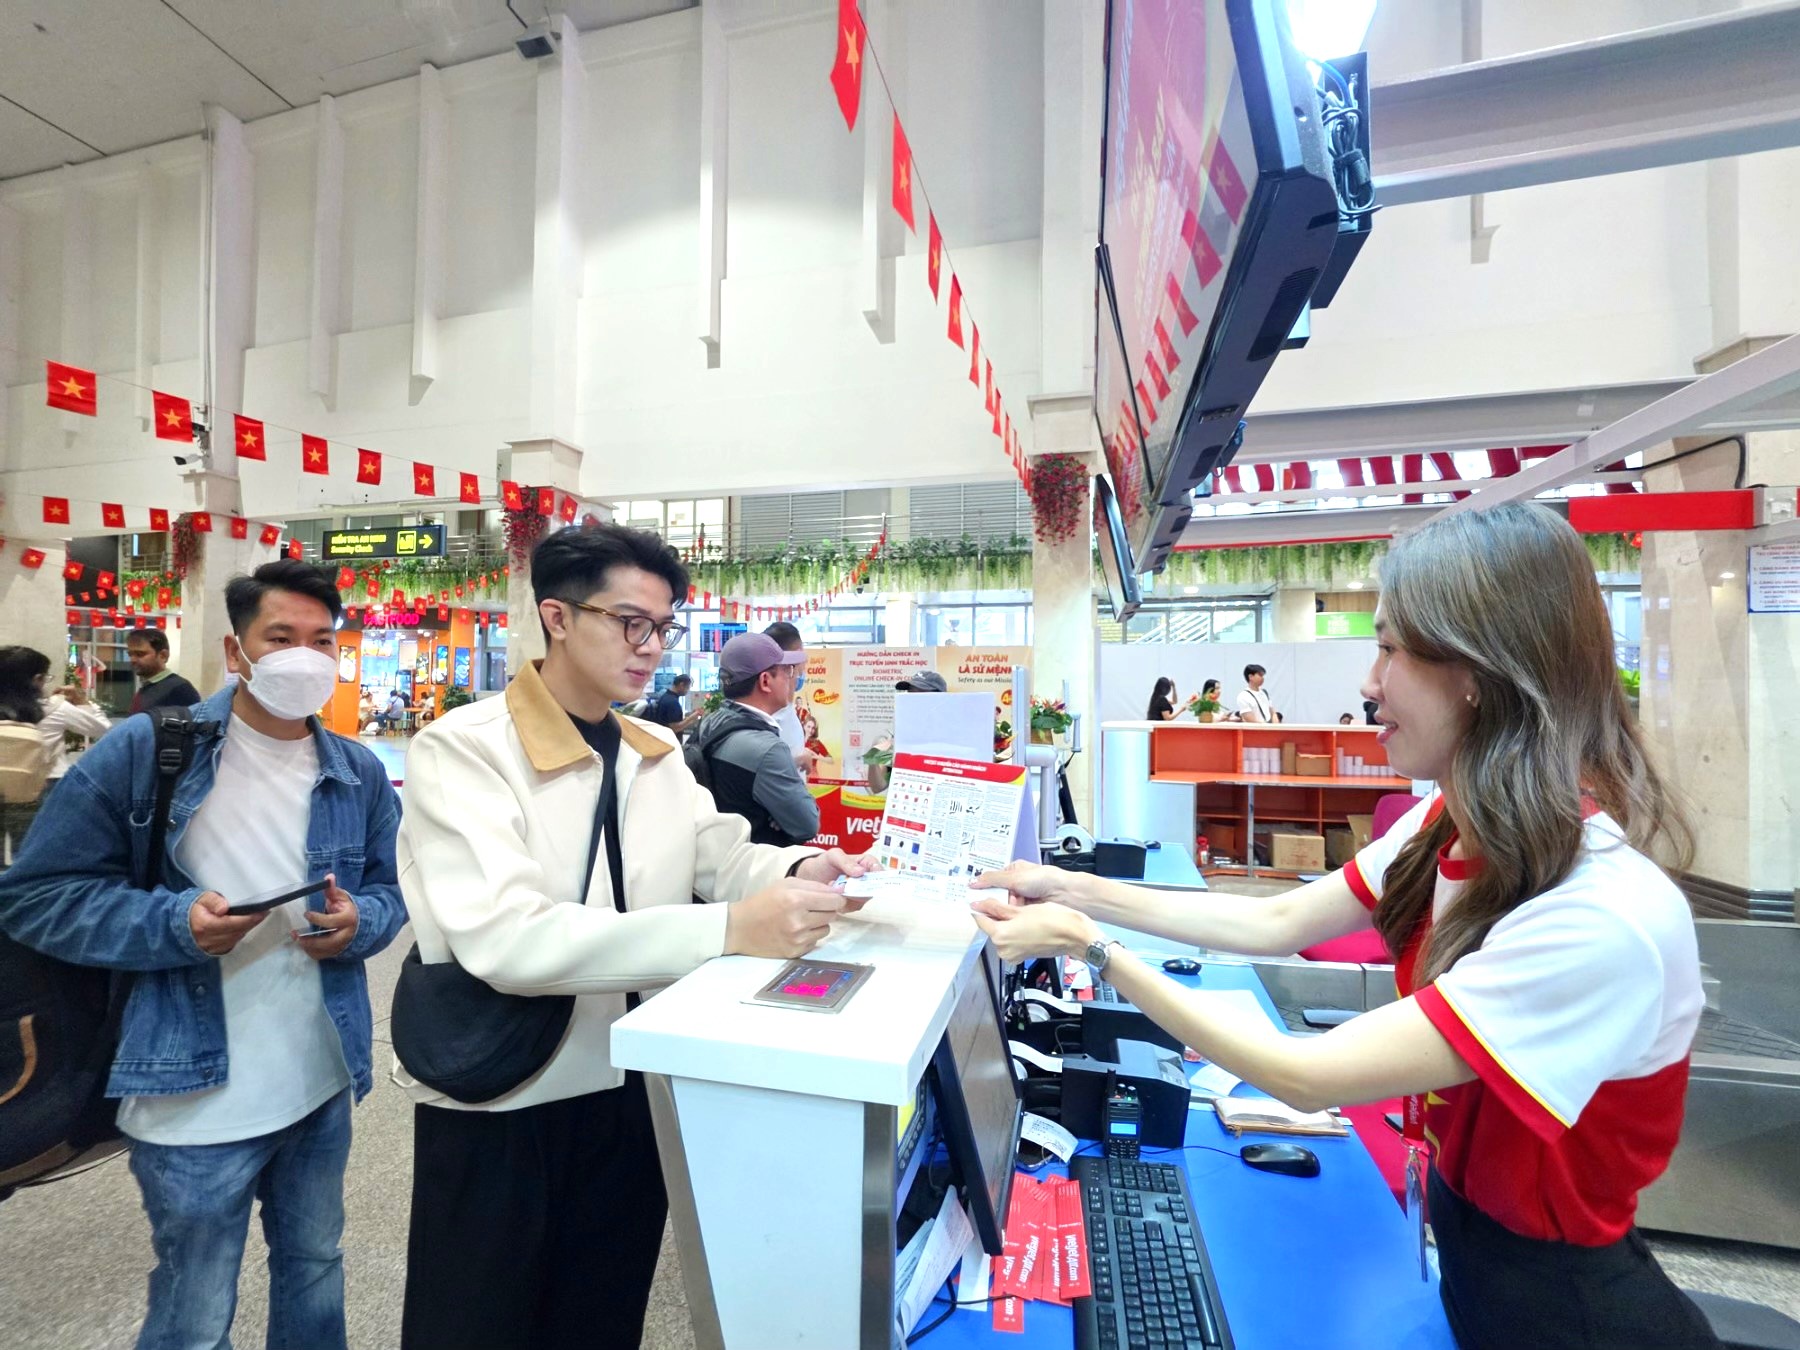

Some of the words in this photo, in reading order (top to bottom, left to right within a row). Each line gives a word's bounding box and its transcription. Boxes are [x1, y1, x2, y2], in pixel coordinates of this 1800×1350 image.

[965, 654, 980, 662] AN
[981, 652, 1009, 662] TOÀN
[958, 663, 971, 674] LÀ
